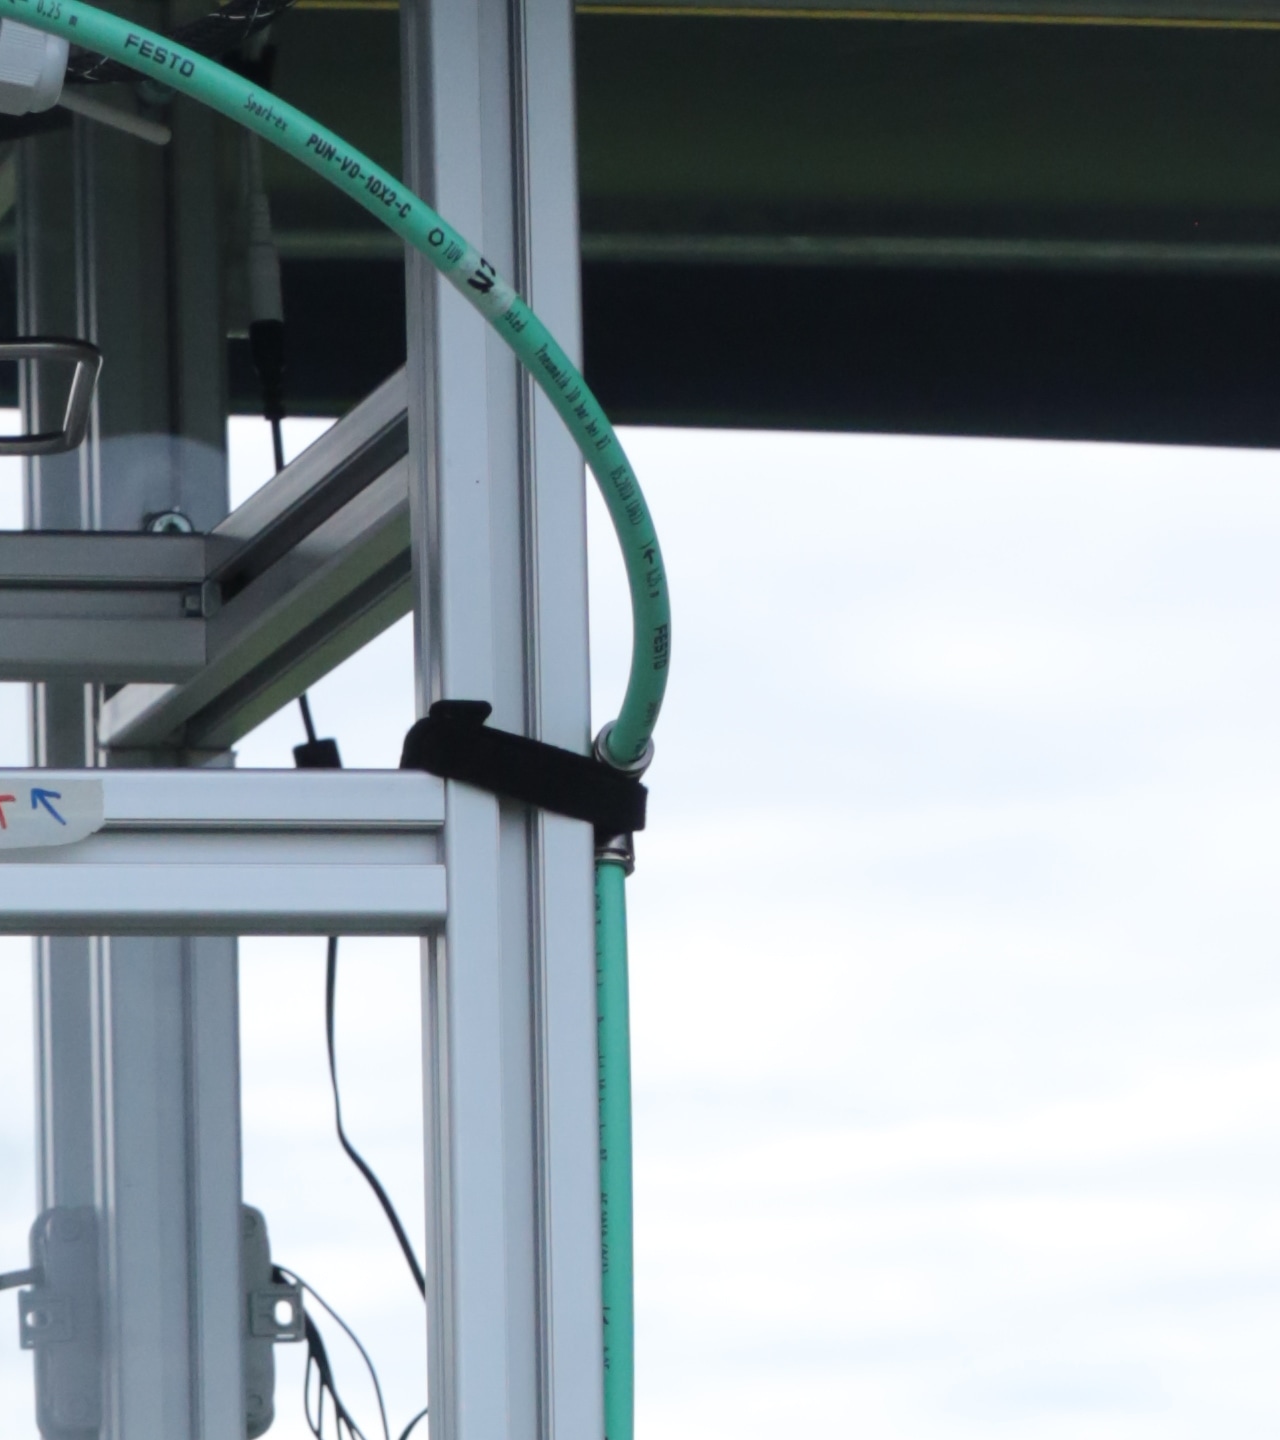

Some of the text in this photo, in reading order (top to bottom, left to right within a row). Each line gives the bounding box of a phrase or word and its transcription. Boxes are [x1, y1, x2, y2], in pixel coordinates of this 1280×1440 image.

[124, 34, 194, 78] FESTO
[243, 94, 287, 132] Spark-ex
[653, 623, 668, 670] FESTO
